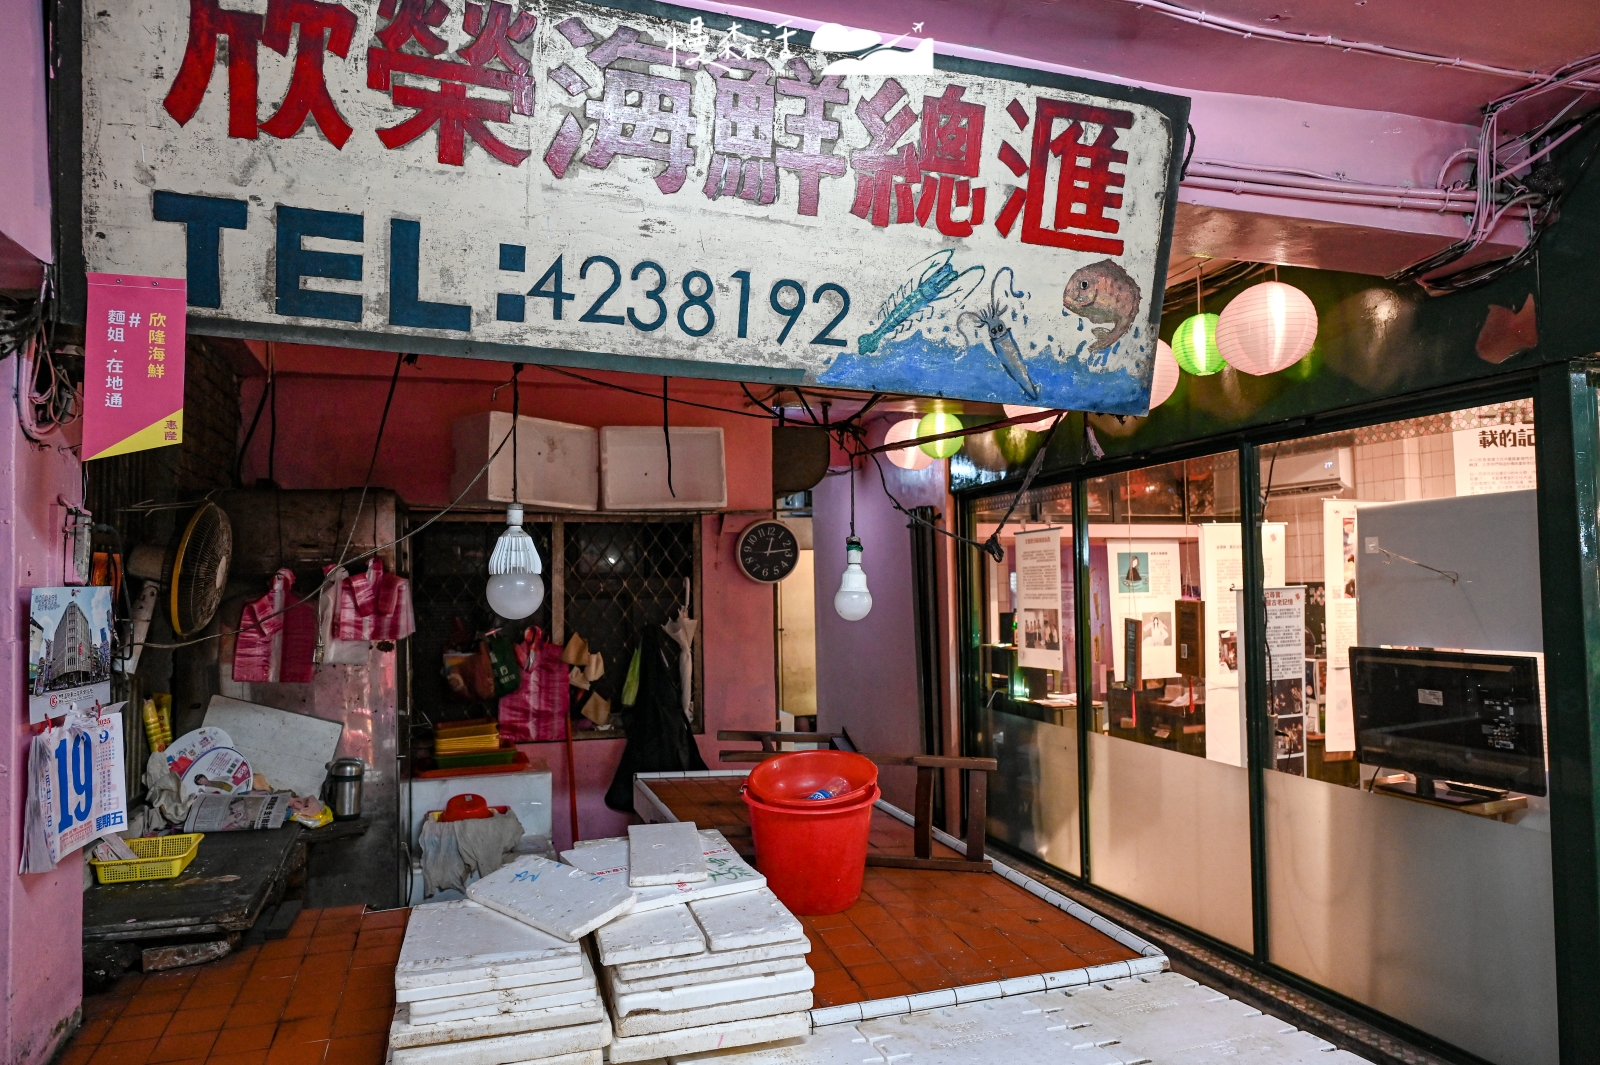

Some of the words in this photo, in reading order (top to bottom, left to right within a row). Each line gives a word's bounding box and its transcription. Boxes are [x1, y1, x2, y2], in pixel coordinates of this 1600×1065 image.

[147, 312, 167, 379] 欣隆海鮮
[767, 526, 776, 536] 12
[762, 567, 769, 577] 6
[773, 565, 780, 575] 5
[98, 729, 109, 744] 9
[55, 731, 93, 834] 19
[95, 810, 124, 832] 星期五
